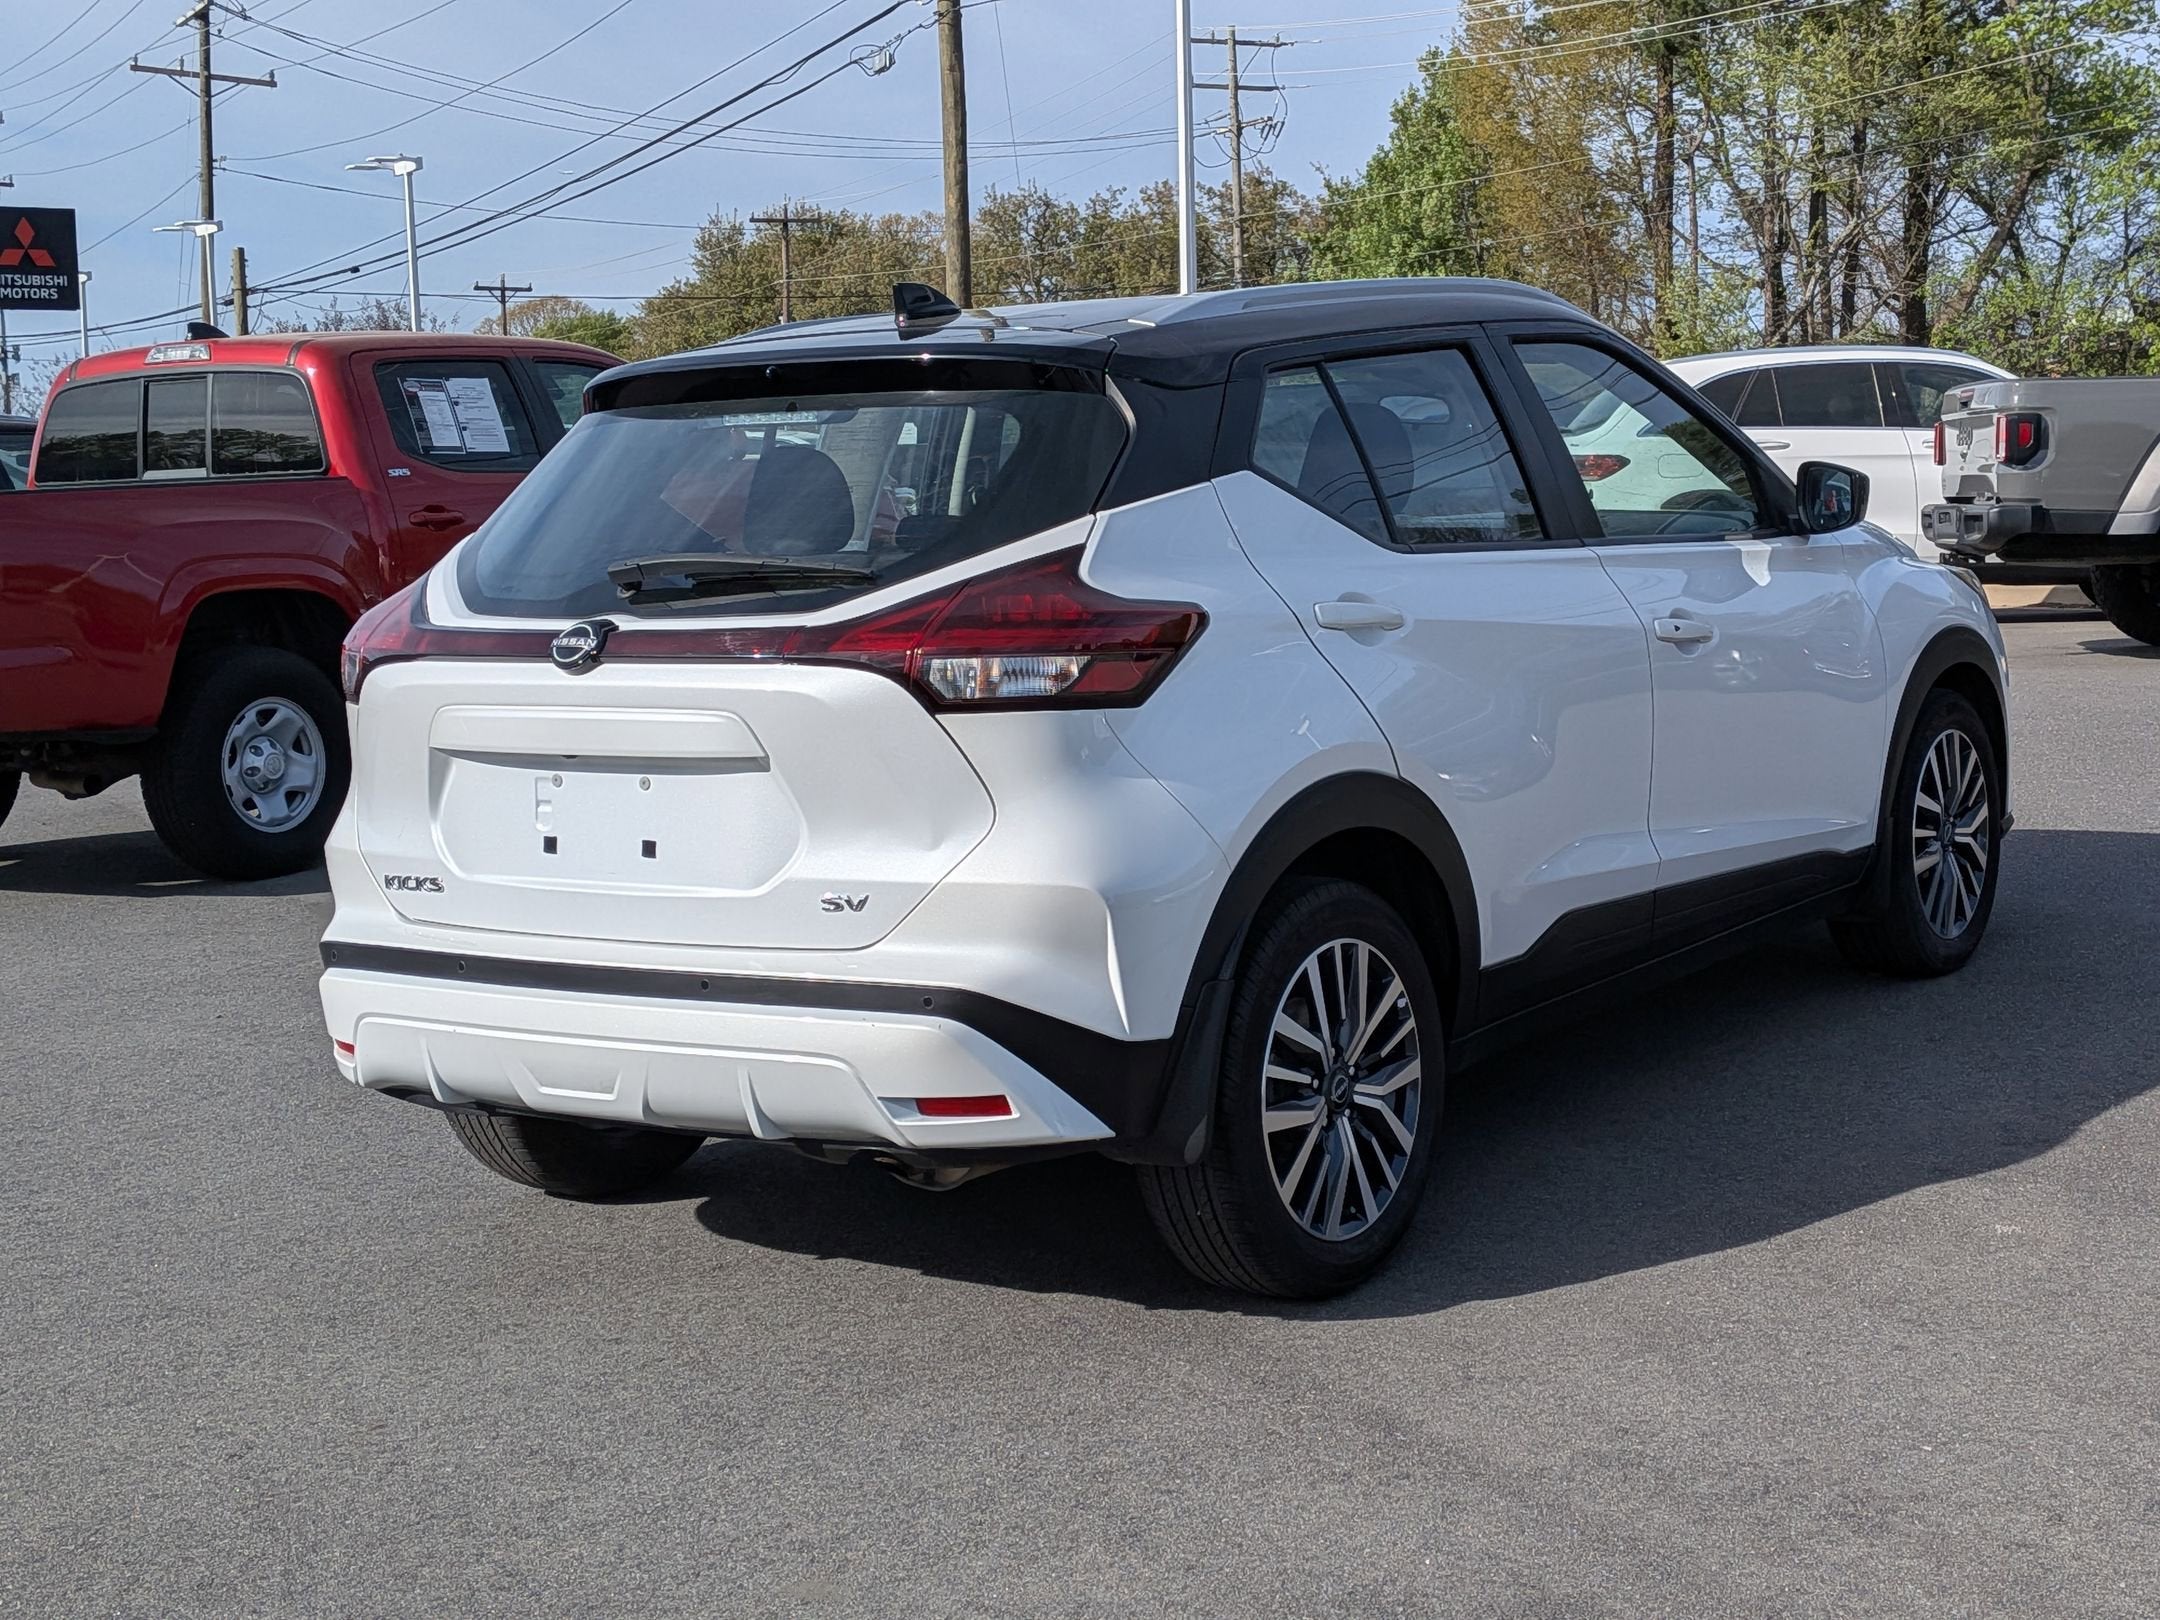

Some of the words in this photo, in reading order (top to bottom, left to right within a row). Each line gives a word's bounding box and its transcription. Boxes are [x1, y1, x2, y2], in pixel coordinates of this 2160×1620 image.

[0, 274, 68, 286] ITSUBISHI
[0, 287, 58, 299] MOTORS
[550, 637, 598, 650] NISSAN
[384, 874, 445, 893] KICKS
[820, 894, 870, 912] SV
